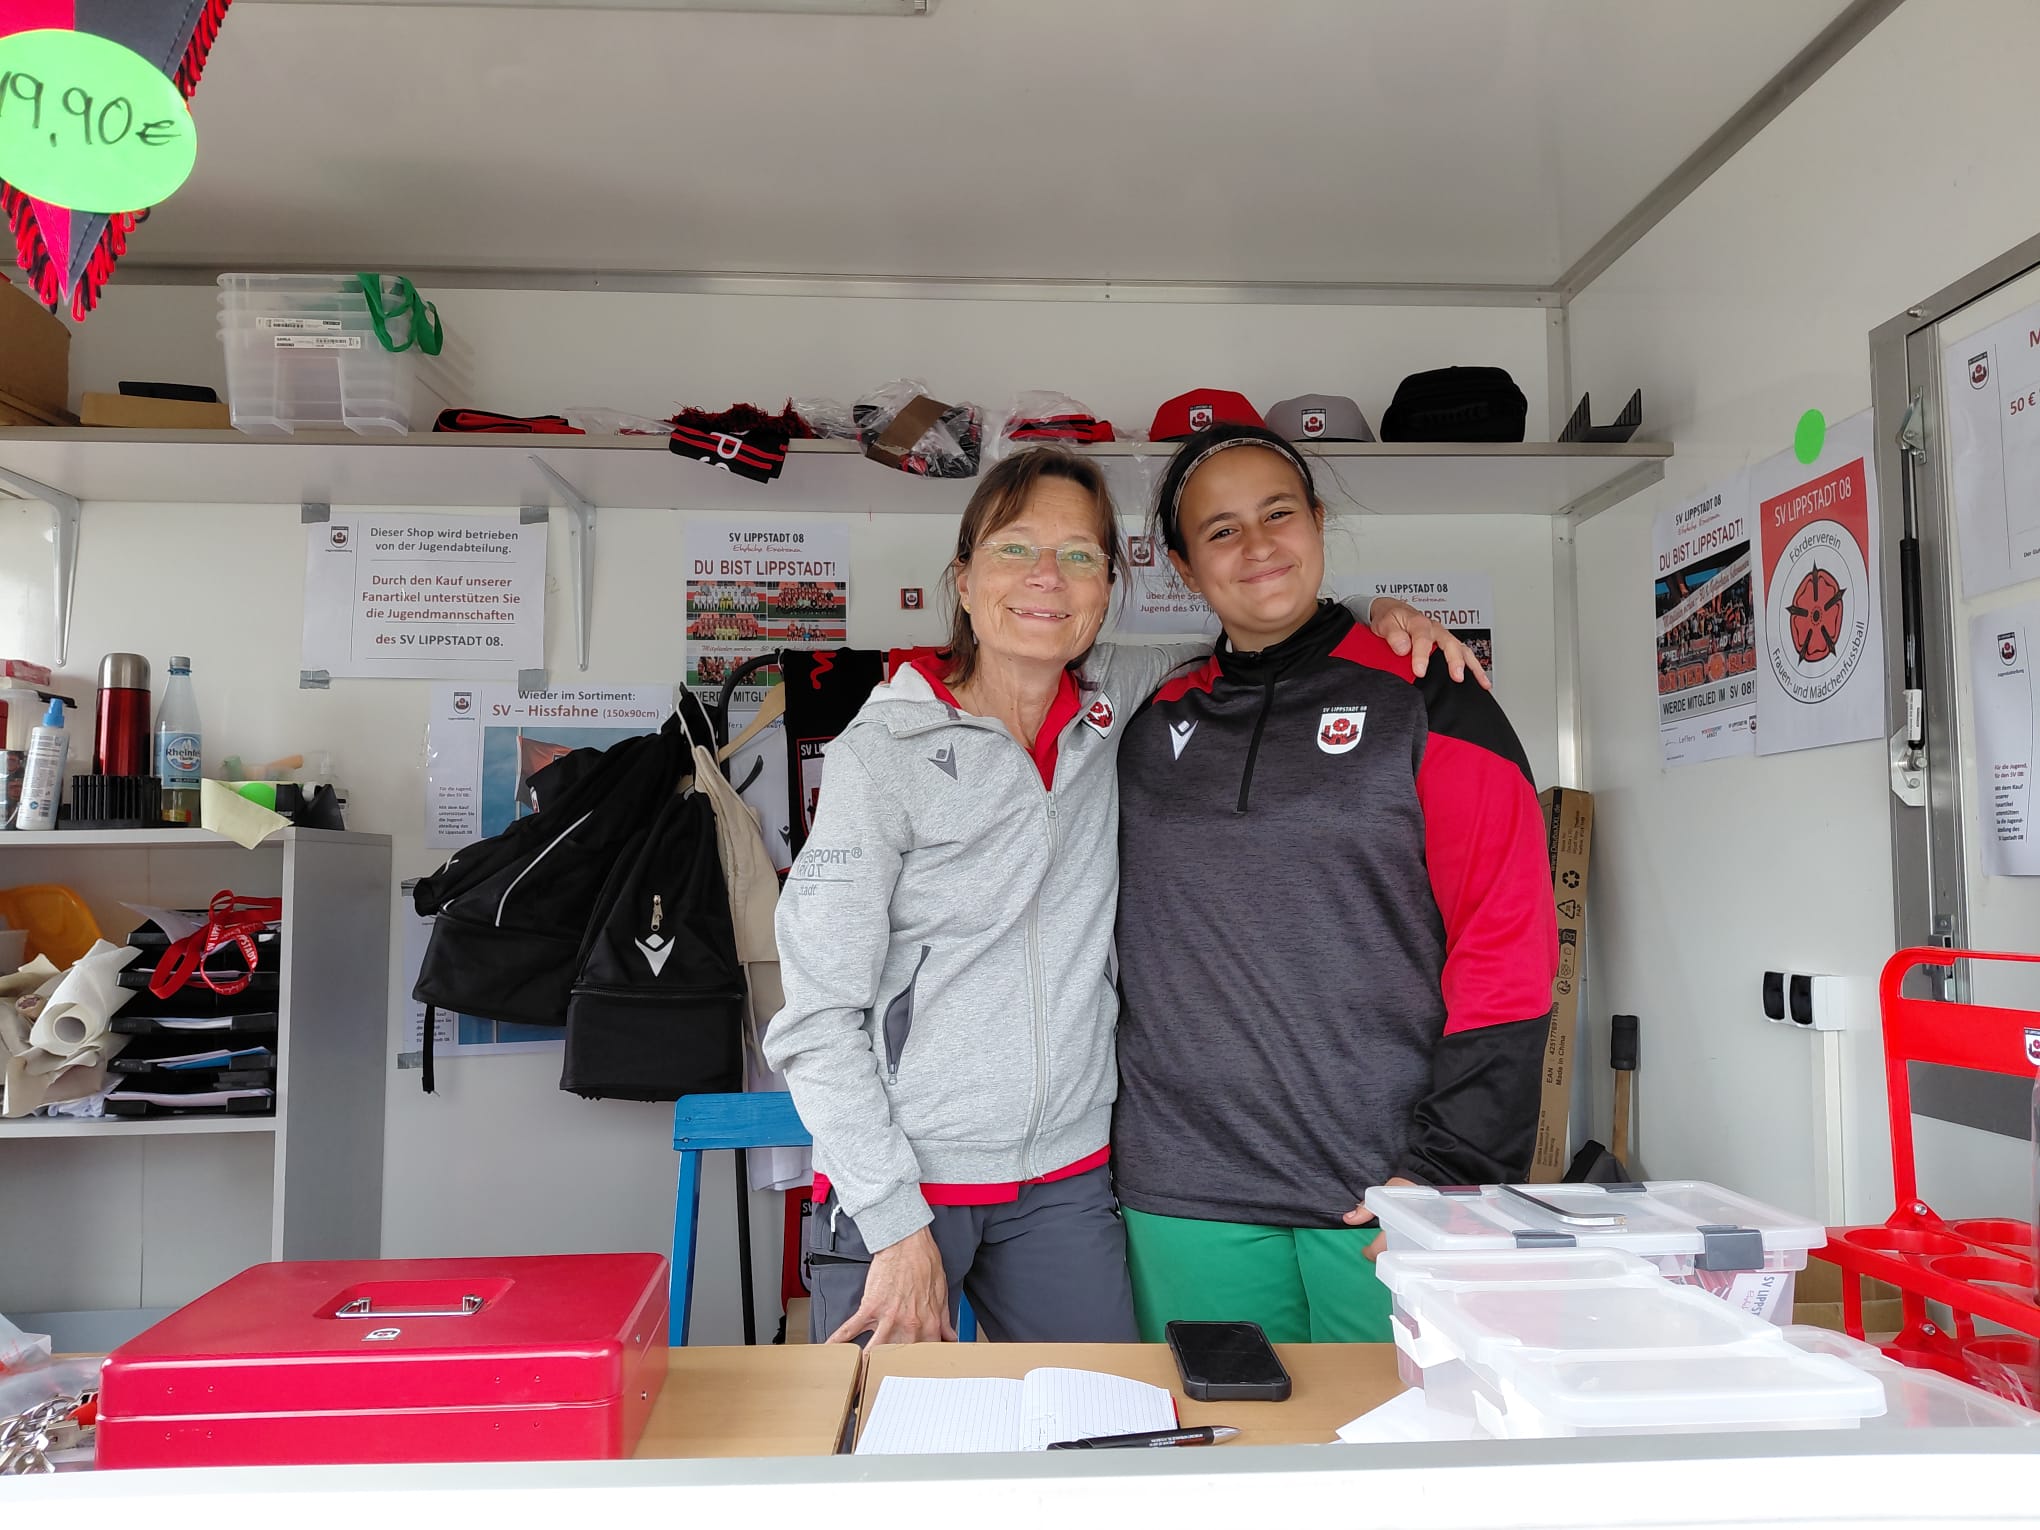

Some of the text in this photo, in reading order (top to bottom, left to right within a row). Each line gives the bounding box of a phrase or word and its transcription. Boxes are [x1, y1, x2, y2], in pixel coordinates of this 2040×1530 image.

[2010, 391, 2036, 416] 50 €
[1774, 476, 1852, 527] SV LIPPSTADT 08
[1676, 494, 1722, 526] SV LIPPSTADT 08
[370, 527, 519, 540] Dieser Shop wird betrieben
[729, 532, 804, 543] SV LIPPSTADT 08
[375, 541, 512, 555] von der Jugendabteilung.
[1660, 517, 1744, 571] DU BIST LIPPSTADT!
[1789, 532, 1841, 563] Förderverein
[694, 559, 836, 577] DU BIST LIPPSTADT!
[372, 575, 512, 588] Durch den Kauf unserer
[1375, 583, 1449, 594] SV LIPPSTADT 08
[362, 592, 521, 604] Fanartikel unterstützen Sie
[1146, 592, 1165, 600] über
[1168, 592, 1186, 600] eine
[366, 608, 515, 621] die Jugendmannschaften
[1140, 604, 1170, 613] Jugend
[1172, 604, 1187, 612] des
[375, 634, 504, 647] des SV LIPPSTADT 08.
[1772, 621, 1865, 699] Frauen- und Mädchenfussball
[518, 690, 636, 701] Wieder im Sortiment:
[1663, 680, 1755, 715] WERDE MITGLIED IM SV 08!
[492, 704, 511, 717] SV
[528, 704, 599, 717] Hissfahne
[602, 707, 660, 720] (150x90cm)
[801, 743, 812, 756] SV
[1558, 1035, 1566, 1056] China
[1761, 1276, 1775, 1288] SV
